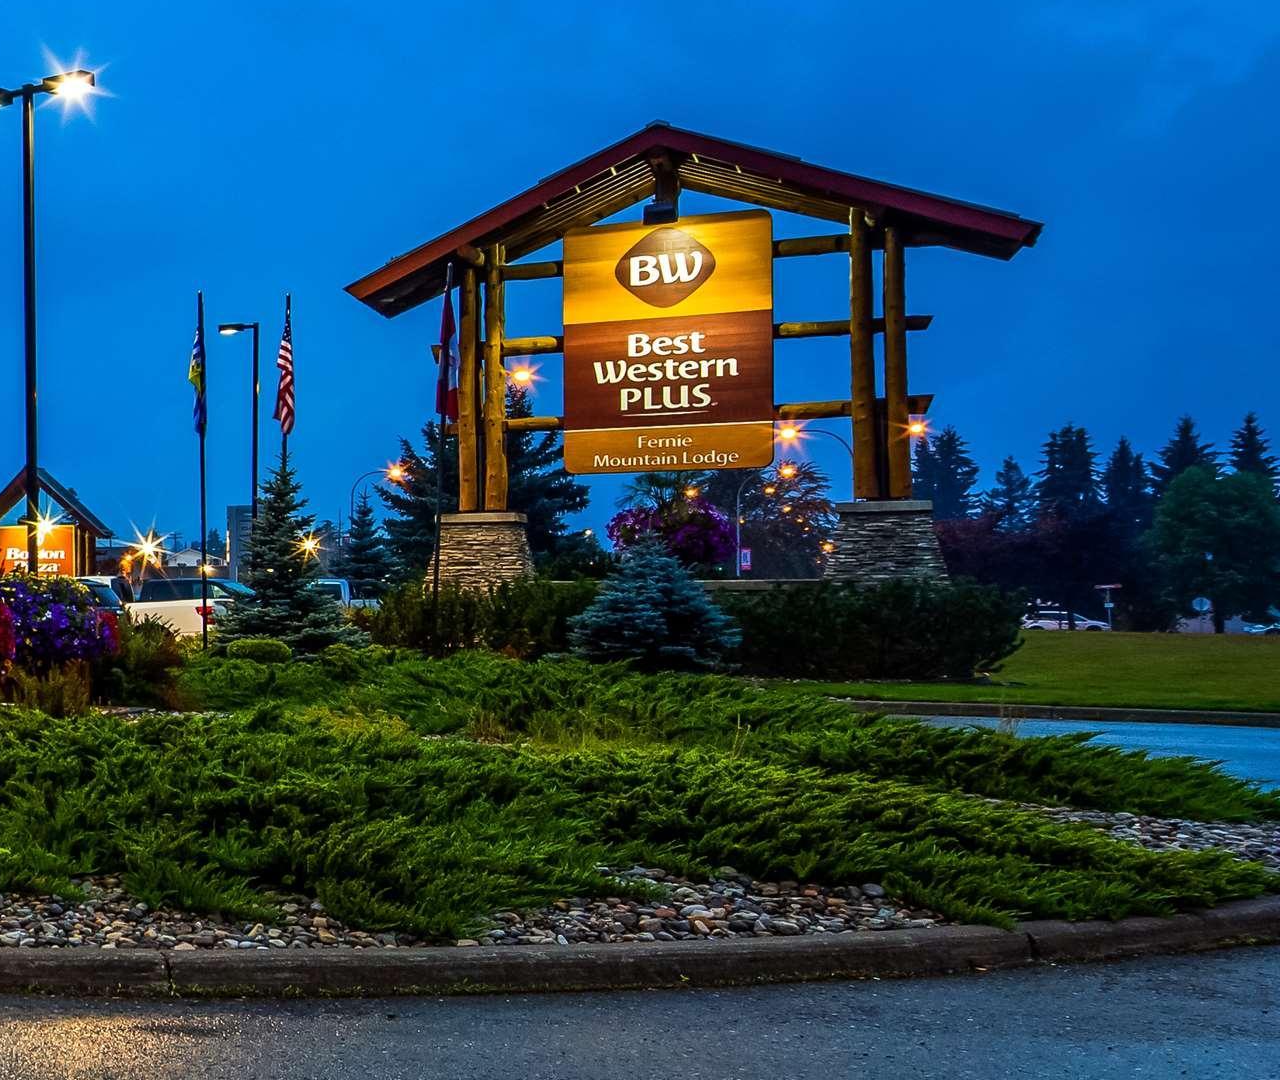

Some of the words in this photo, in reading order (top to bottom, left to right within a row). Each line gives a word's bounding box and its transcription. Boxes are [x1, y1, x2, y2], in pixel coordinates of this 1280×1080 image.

[629, 250, 703, 287] BW
[627, 330, 706, 357] Best
[593, 357, 739, 384] Western
[620, 383, 712, 411] PLUS
[637, 435, 693, 448] Fernie
[593, 450, 678, 467] Mountain
[682, 449, 739, 466] Lodge
[6, 548, 65, 559] Boton
